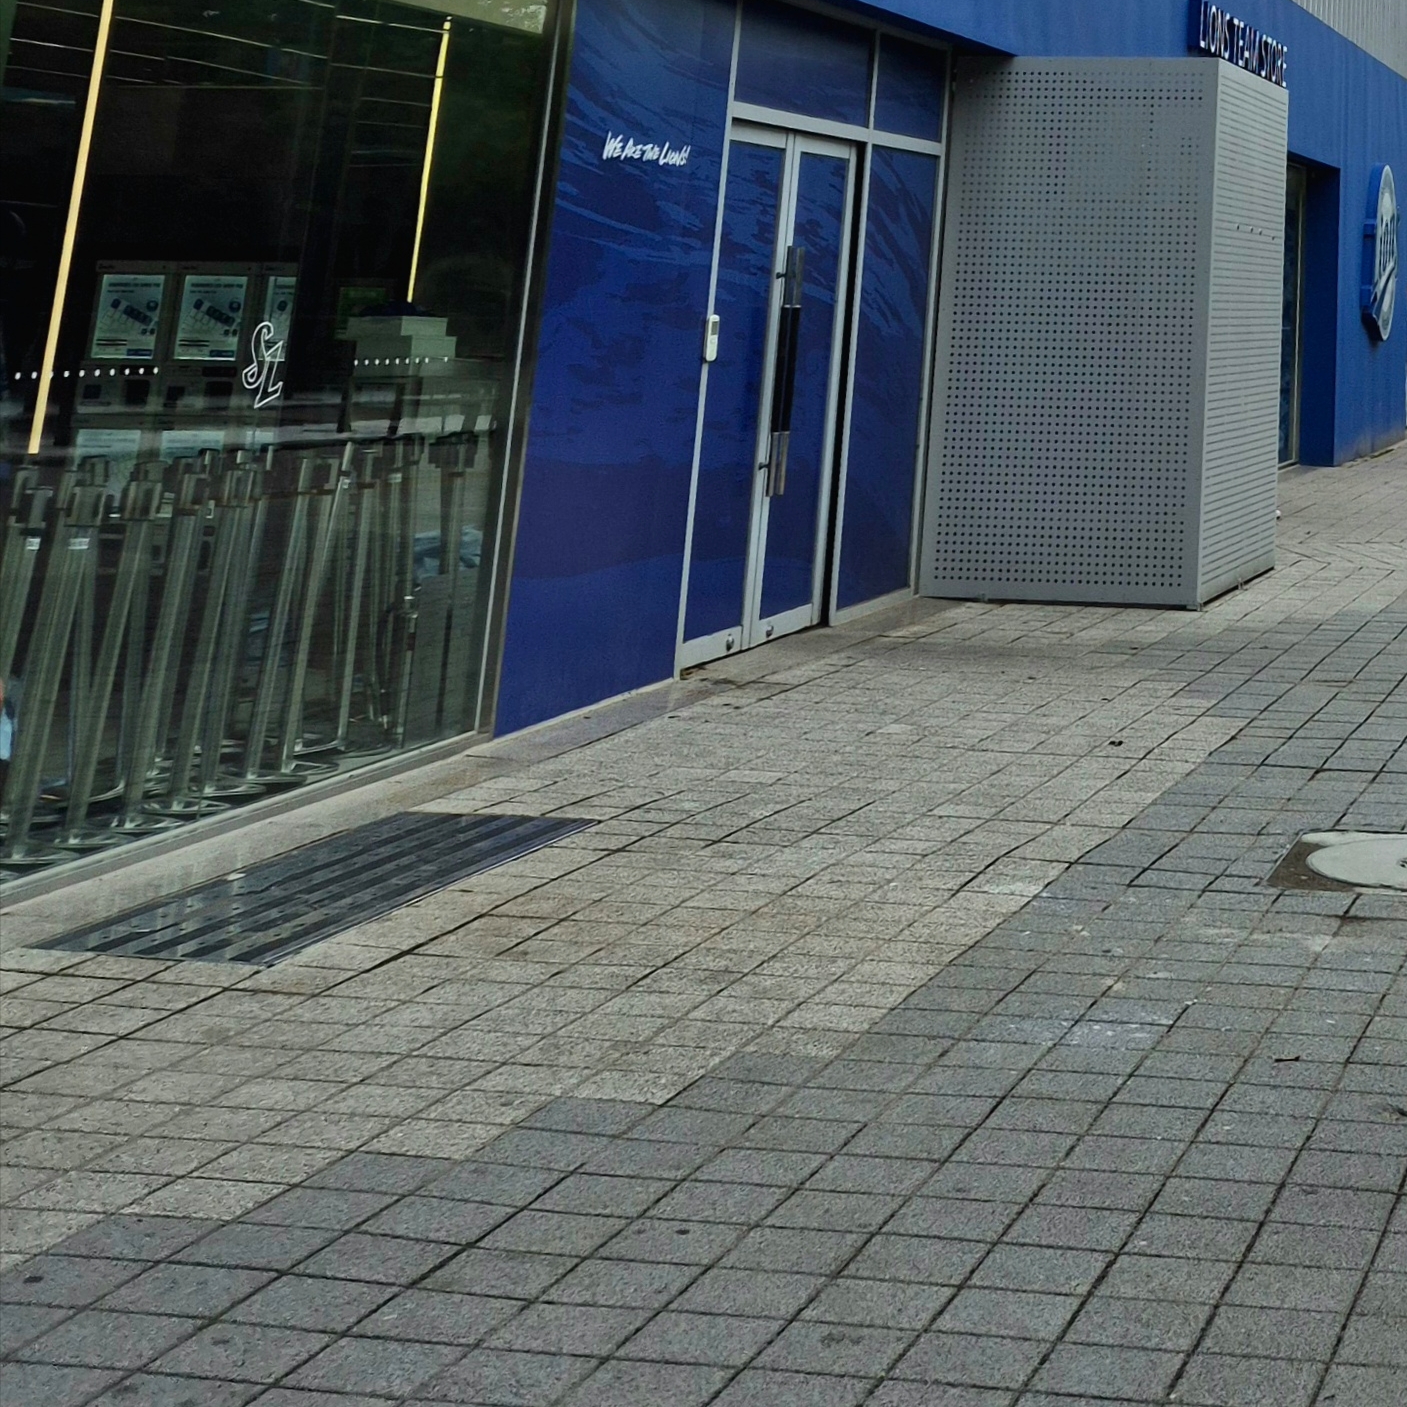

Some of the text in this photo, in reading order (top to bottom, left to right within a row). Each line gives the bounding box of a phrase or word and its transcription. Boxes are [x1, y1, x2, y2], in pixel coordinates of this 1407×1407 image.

[1199, 0, 1288, 88] LIONS TEAM STORE
